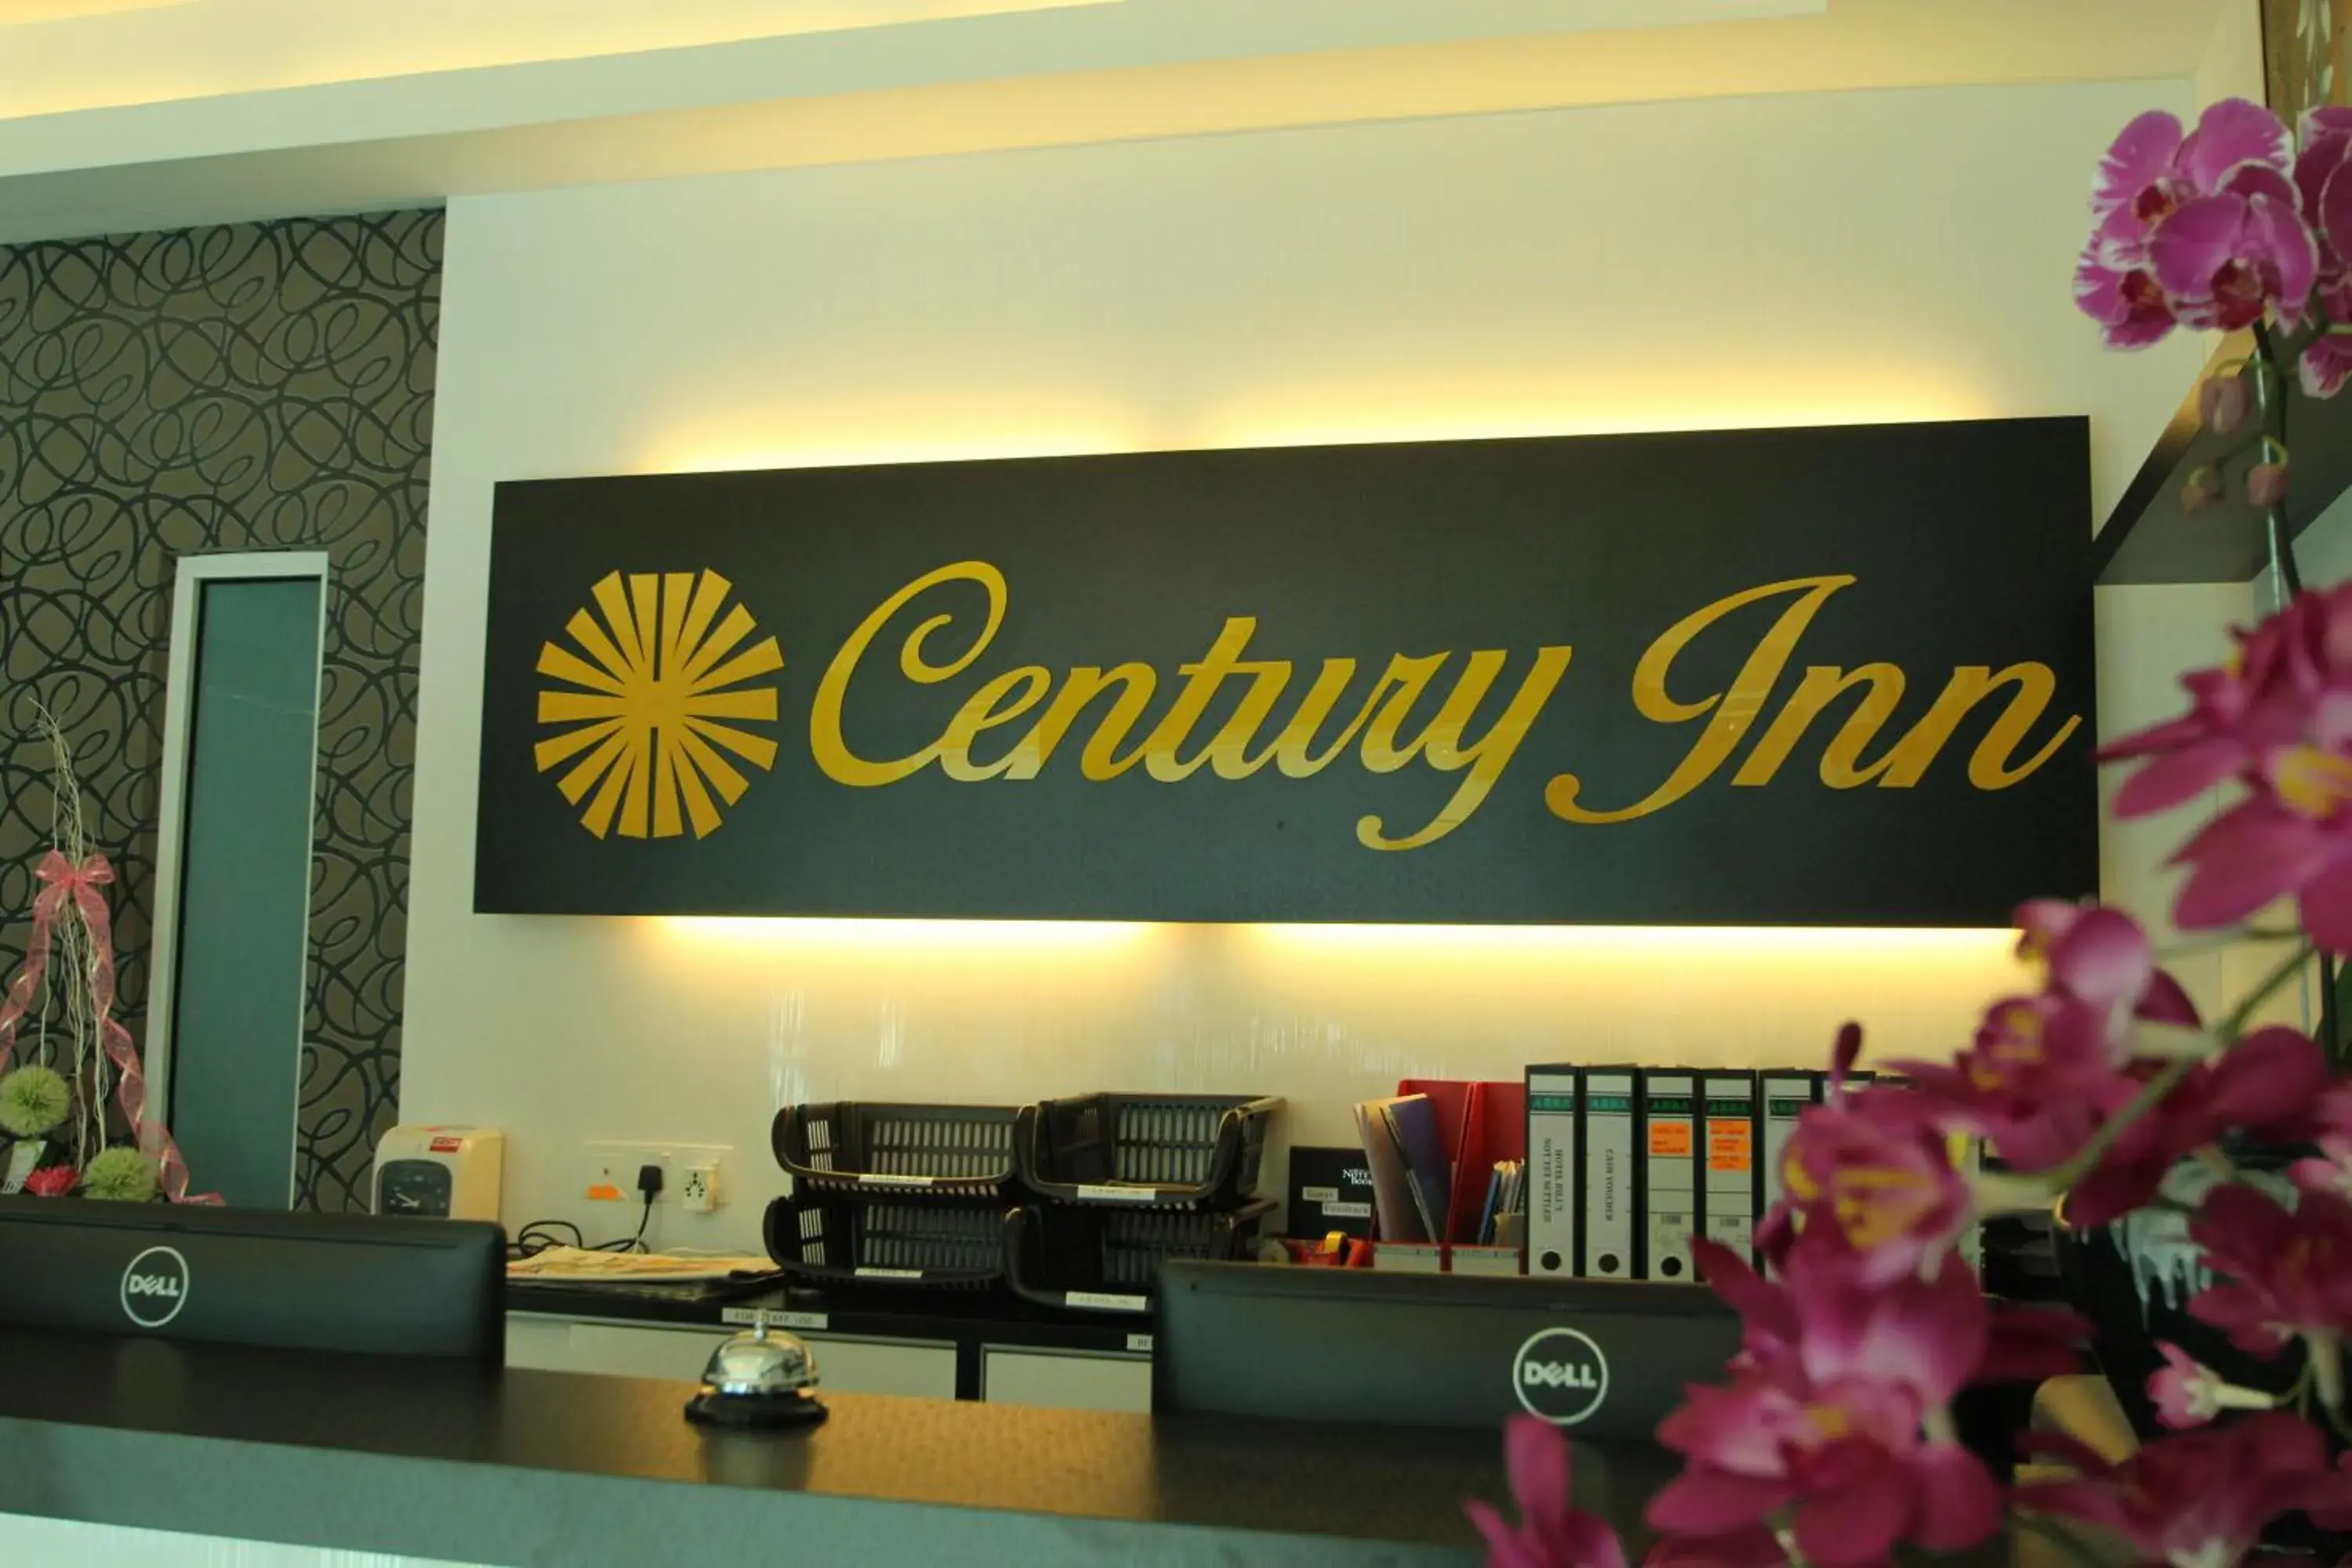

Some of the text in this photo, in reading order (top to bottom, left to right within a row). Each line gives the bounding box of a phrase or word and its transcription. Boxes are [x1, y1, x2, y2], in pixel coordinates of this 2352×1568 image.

[809, 560, 2082, 851] Century Inn
[129, 1274, 180, 1297] DELL
[1524, 1361, 1597, 1388] DELL
